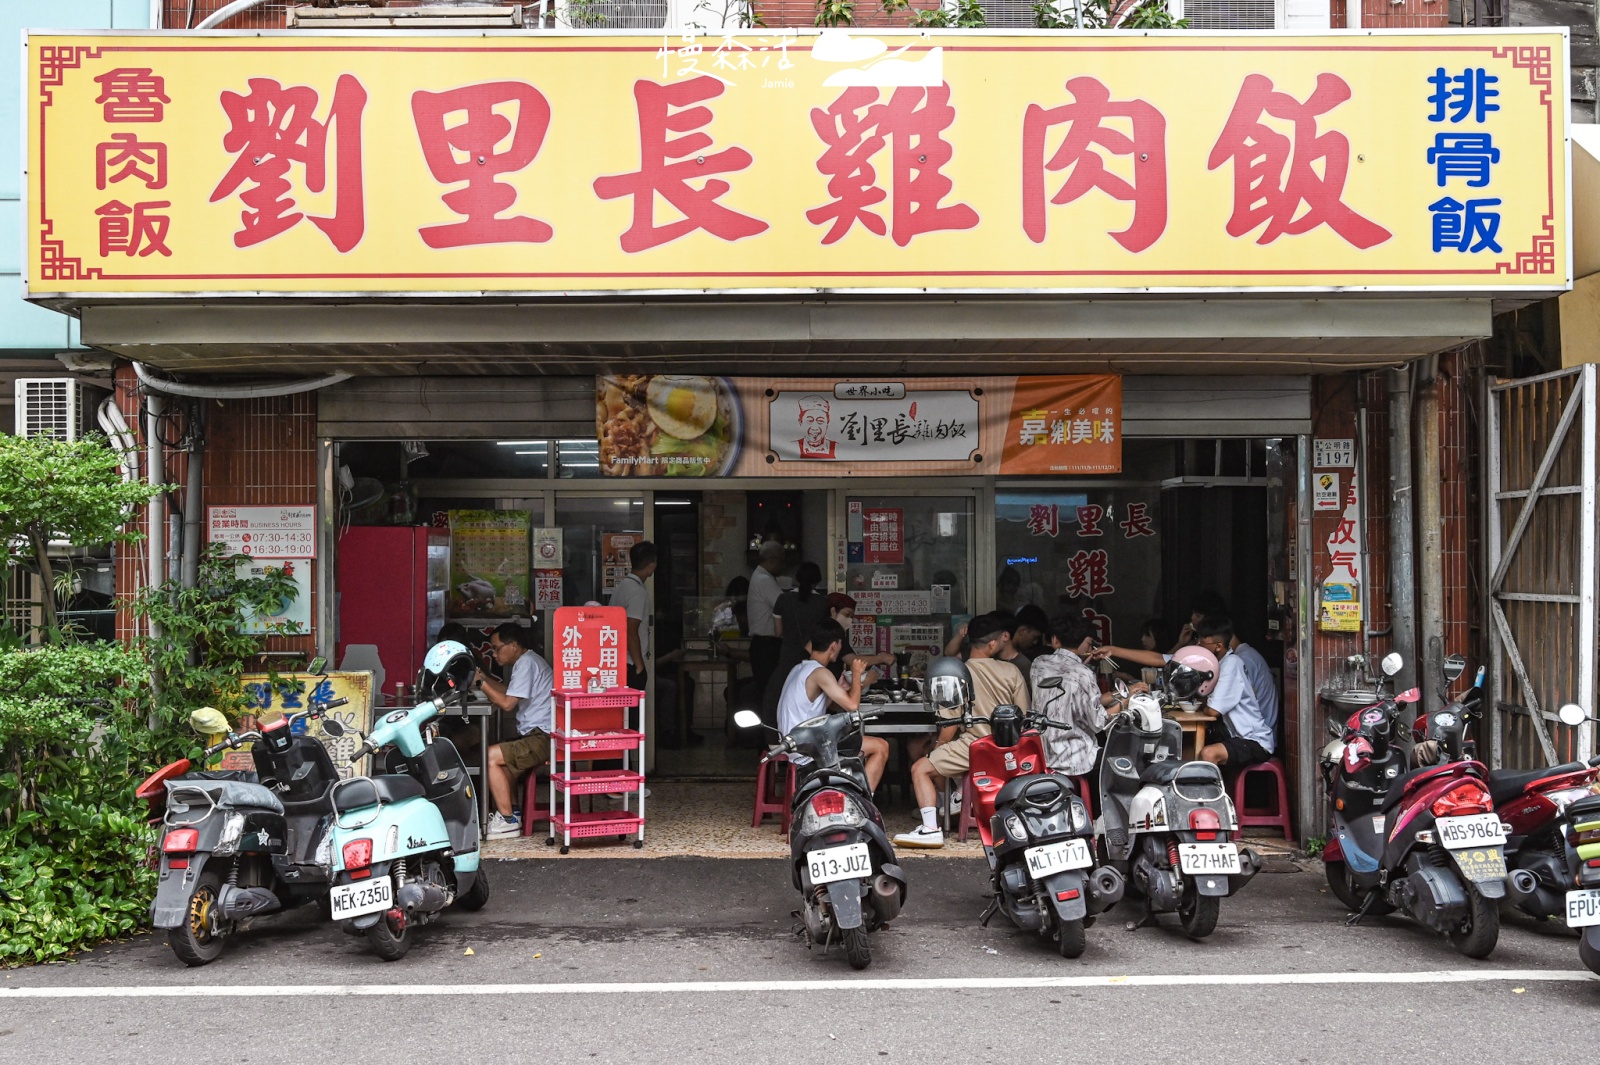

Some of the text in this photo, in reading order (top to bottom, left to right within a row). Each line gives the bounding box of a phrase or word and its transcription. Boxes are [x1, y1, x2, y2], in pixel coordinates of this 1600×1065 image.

[94, 67, 173, 257] 魯肉飯
[208, 72, 1393, 254] 劉里長雞肉飯
[1427, 67, 1503, 253] 排骨飯
[846, 385, 895, 397] 世界小吃
[839, 411, 967, 446] 劉里長雞肉飯
[1019, 408, 1115, 446] 嘉鄉美味
[1324, 441, 1350, 449] 公明路
[611, 455, 659, 465] FamilyMart
[1325, 452, 1350, 464] 197
[212, 519, 249, 528] 營業時間
[1027, 502, 1156, 539] 劉里長
[252, 532, 312, 542] 07:30-14:30
[253, 544, 312, 554] 16:30-19:00
[538, 590, 561, 601] 外食
[852, 624, 874, 635] 禁帶
[852, 635, 874, 646] 外食
[562, 625, 583, 689] 外帶單
